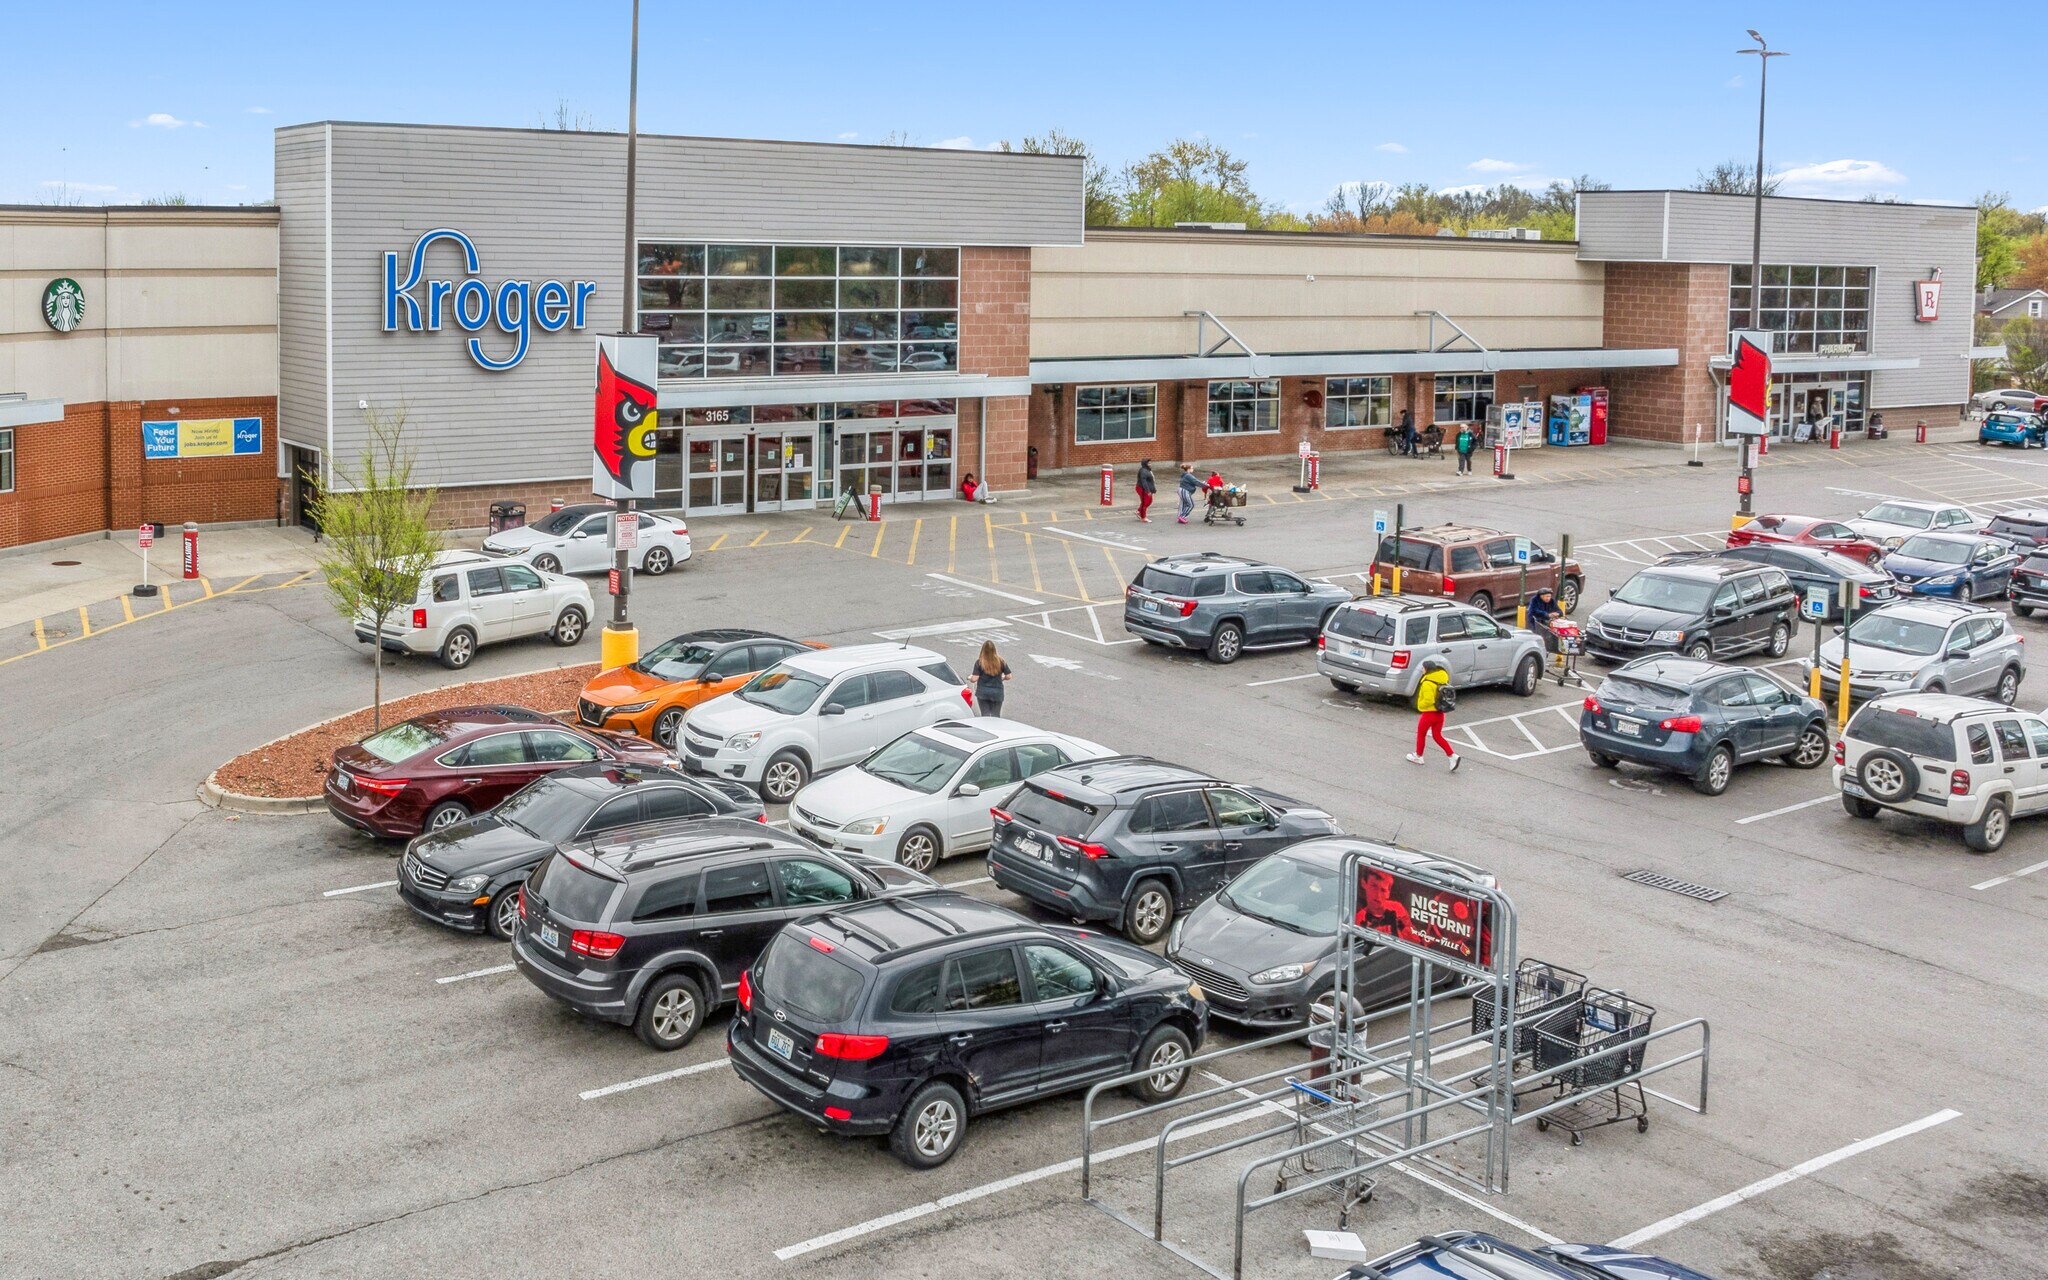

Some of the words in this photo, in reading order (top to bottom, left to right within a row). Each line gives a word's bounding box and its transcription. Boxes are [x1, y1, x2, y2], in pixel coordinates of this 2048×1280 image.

[383, 227, 596, 371] Kroger
[1818, 343, 1856, 355] PHARMACY
[705, 410, 729, 422] 3165
[153, 428, 175, 436] Feed
[237, 430, 258, 443] Kroger
[155, 436, 175, 444] Your
[147, 444, 175, 452] Future
[185, 537, 193, 573] LOUISVILLE
[1410, 893, 1449, 918] NICE
[1410, 907, 1471, 938] RETURN!
[1440, 938, 1460, 951] VILLE
